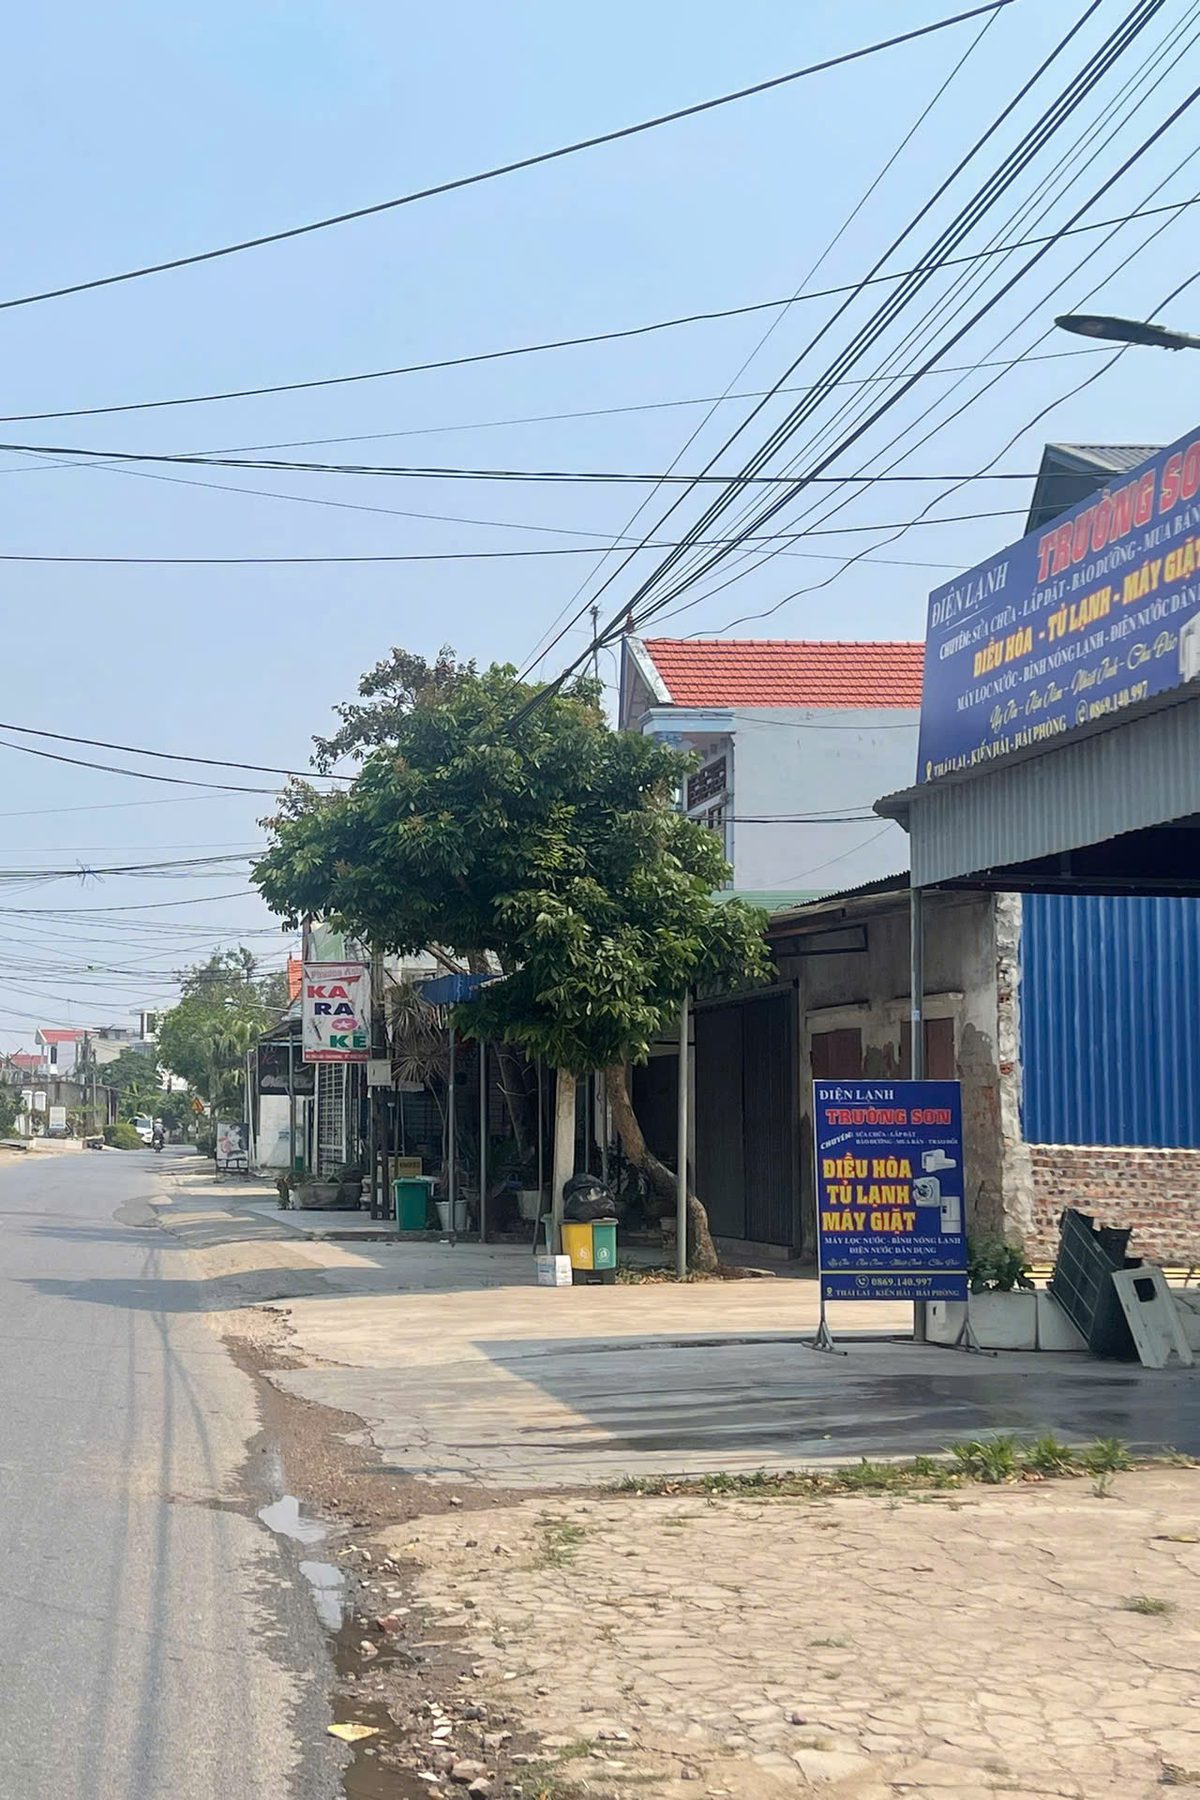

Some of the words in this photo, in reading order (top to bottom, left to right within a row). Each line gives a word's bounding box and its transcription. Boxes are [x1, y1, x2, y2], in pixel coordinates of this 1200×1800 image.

[1143, 521, 1171, 551] MUA
[931, 586, 965, 629] ĐIỆN
[965, 561, 1009, 609] LẠNH
[1004, 626, 1033, 663] HÒA
[1048, 602, 1068, 643] TỦ
[1069, 586, 1111, 631] LẠNH
[1123, 559, 1162, 605] MÁY
[1076, 630, 1105, 659] LẠNH
[307, 985, 348, 998] KA
[314, 1003, 354, 1015] RA
[820, 1087, 853, 1103] ĐIỆN
[856, 1090, 894, 1103] LẠNH
[872, 1155, 912, 1178] HÒA
[826, 1180, 852, 1205] TỦ
[856, 1185, 910, 1207] LẠNH
[822, 1208, 866, 1232] MÁY
[870, 1208, 916, 1235] GIẶT
[871, 1277, 933, 1287] 0869.140.997
